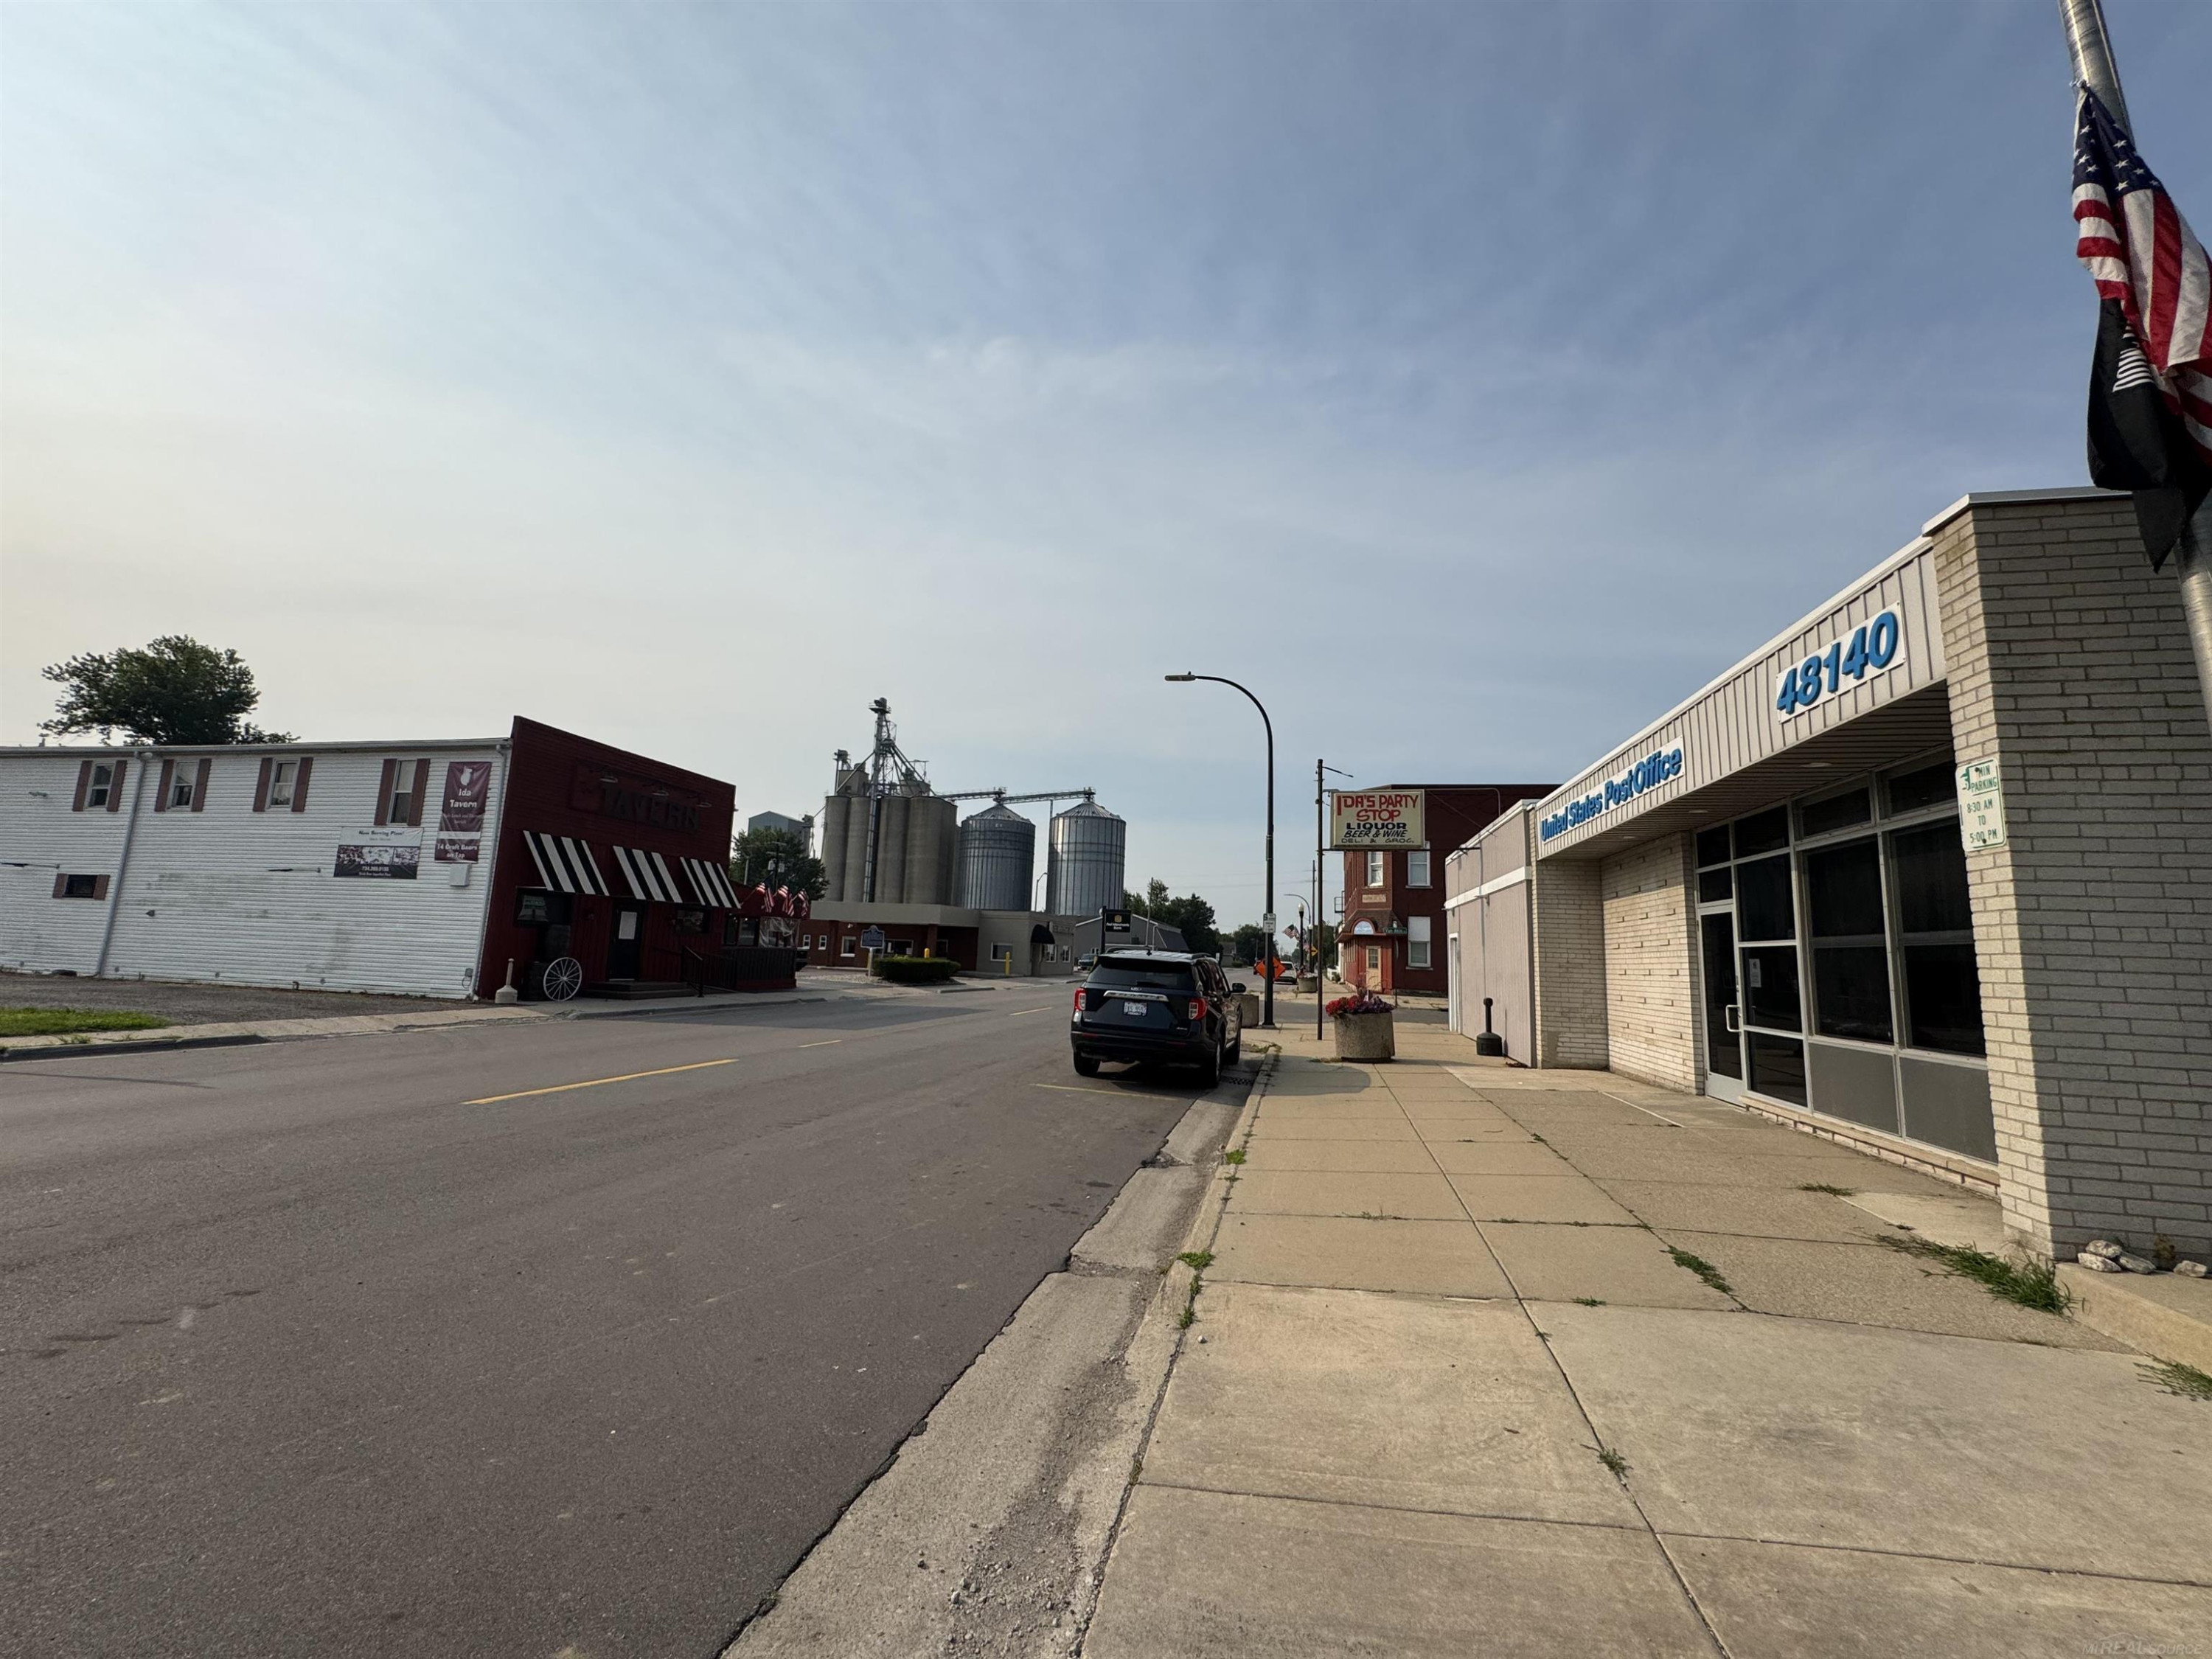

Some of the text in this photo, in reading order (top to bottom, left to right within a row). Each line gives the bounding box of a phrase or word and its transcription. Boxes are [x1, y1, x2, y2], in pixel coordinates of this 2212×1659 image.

[1776, 611, 1899, 715] 48140
[1978, 765, 1991, 777] MIN
[1970, 776, 1997, 793] PARKING
[458, 788, 472, 796] Ida
[1541, 748, 1682, 842] United States Post Office
[449, 799, 478, 808] Tavern
[602, 782, 700, 832] TAVERN
[1337, 794, 1419, 816] IDA'S PARTY
[1966, 798, 1993, 813] 8:30 AM
[1356, 808, 1401, 822] STOP
[1978, 814, 1986, 827] TO
[1346, 822, 1408, 831] LIQUOR
[1343, 830, 1408, 838] BEER & WINE
[1969, 828, 1997, 844] 5:00 PM
